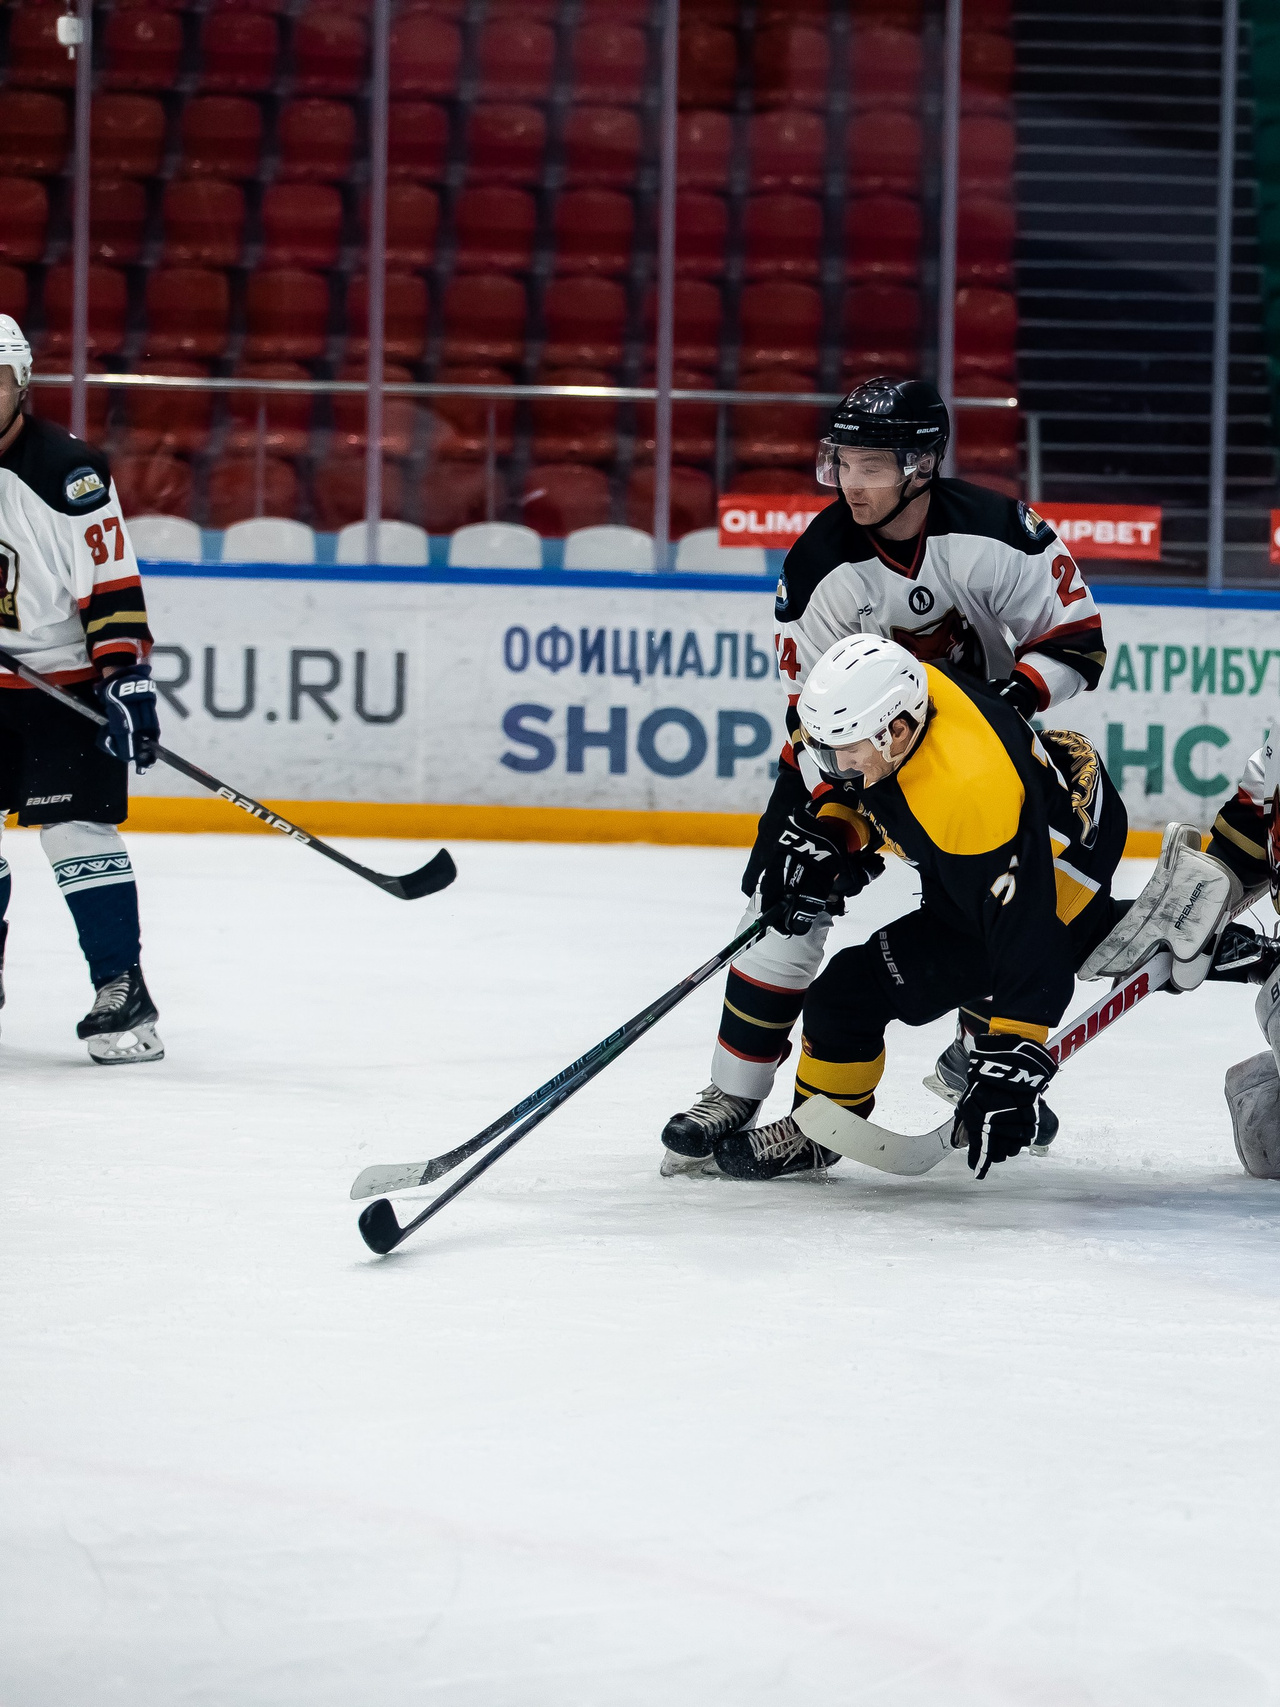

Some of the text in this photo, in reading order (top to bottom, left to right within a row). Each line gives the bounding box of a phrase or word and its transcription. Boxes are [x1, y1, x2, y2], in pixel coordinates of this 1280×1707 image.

[833, 422, 860, 432] BAUER
[915, 426, 940, 435] BAUER
[83, 515, 126, 566] 87
[1046, 518, 1158, 546] MPBET
[1051, 553, 1088, 608] 2
[503, 624, 781, 686] ОФИЦИАЛЬ
[152, 644, 409, 725] RU.RU
[25, 792, 74, 807] BAUER
[1173, 880, 1206, 932] PREMIER
[878, 930, 905, 986] BAUER
